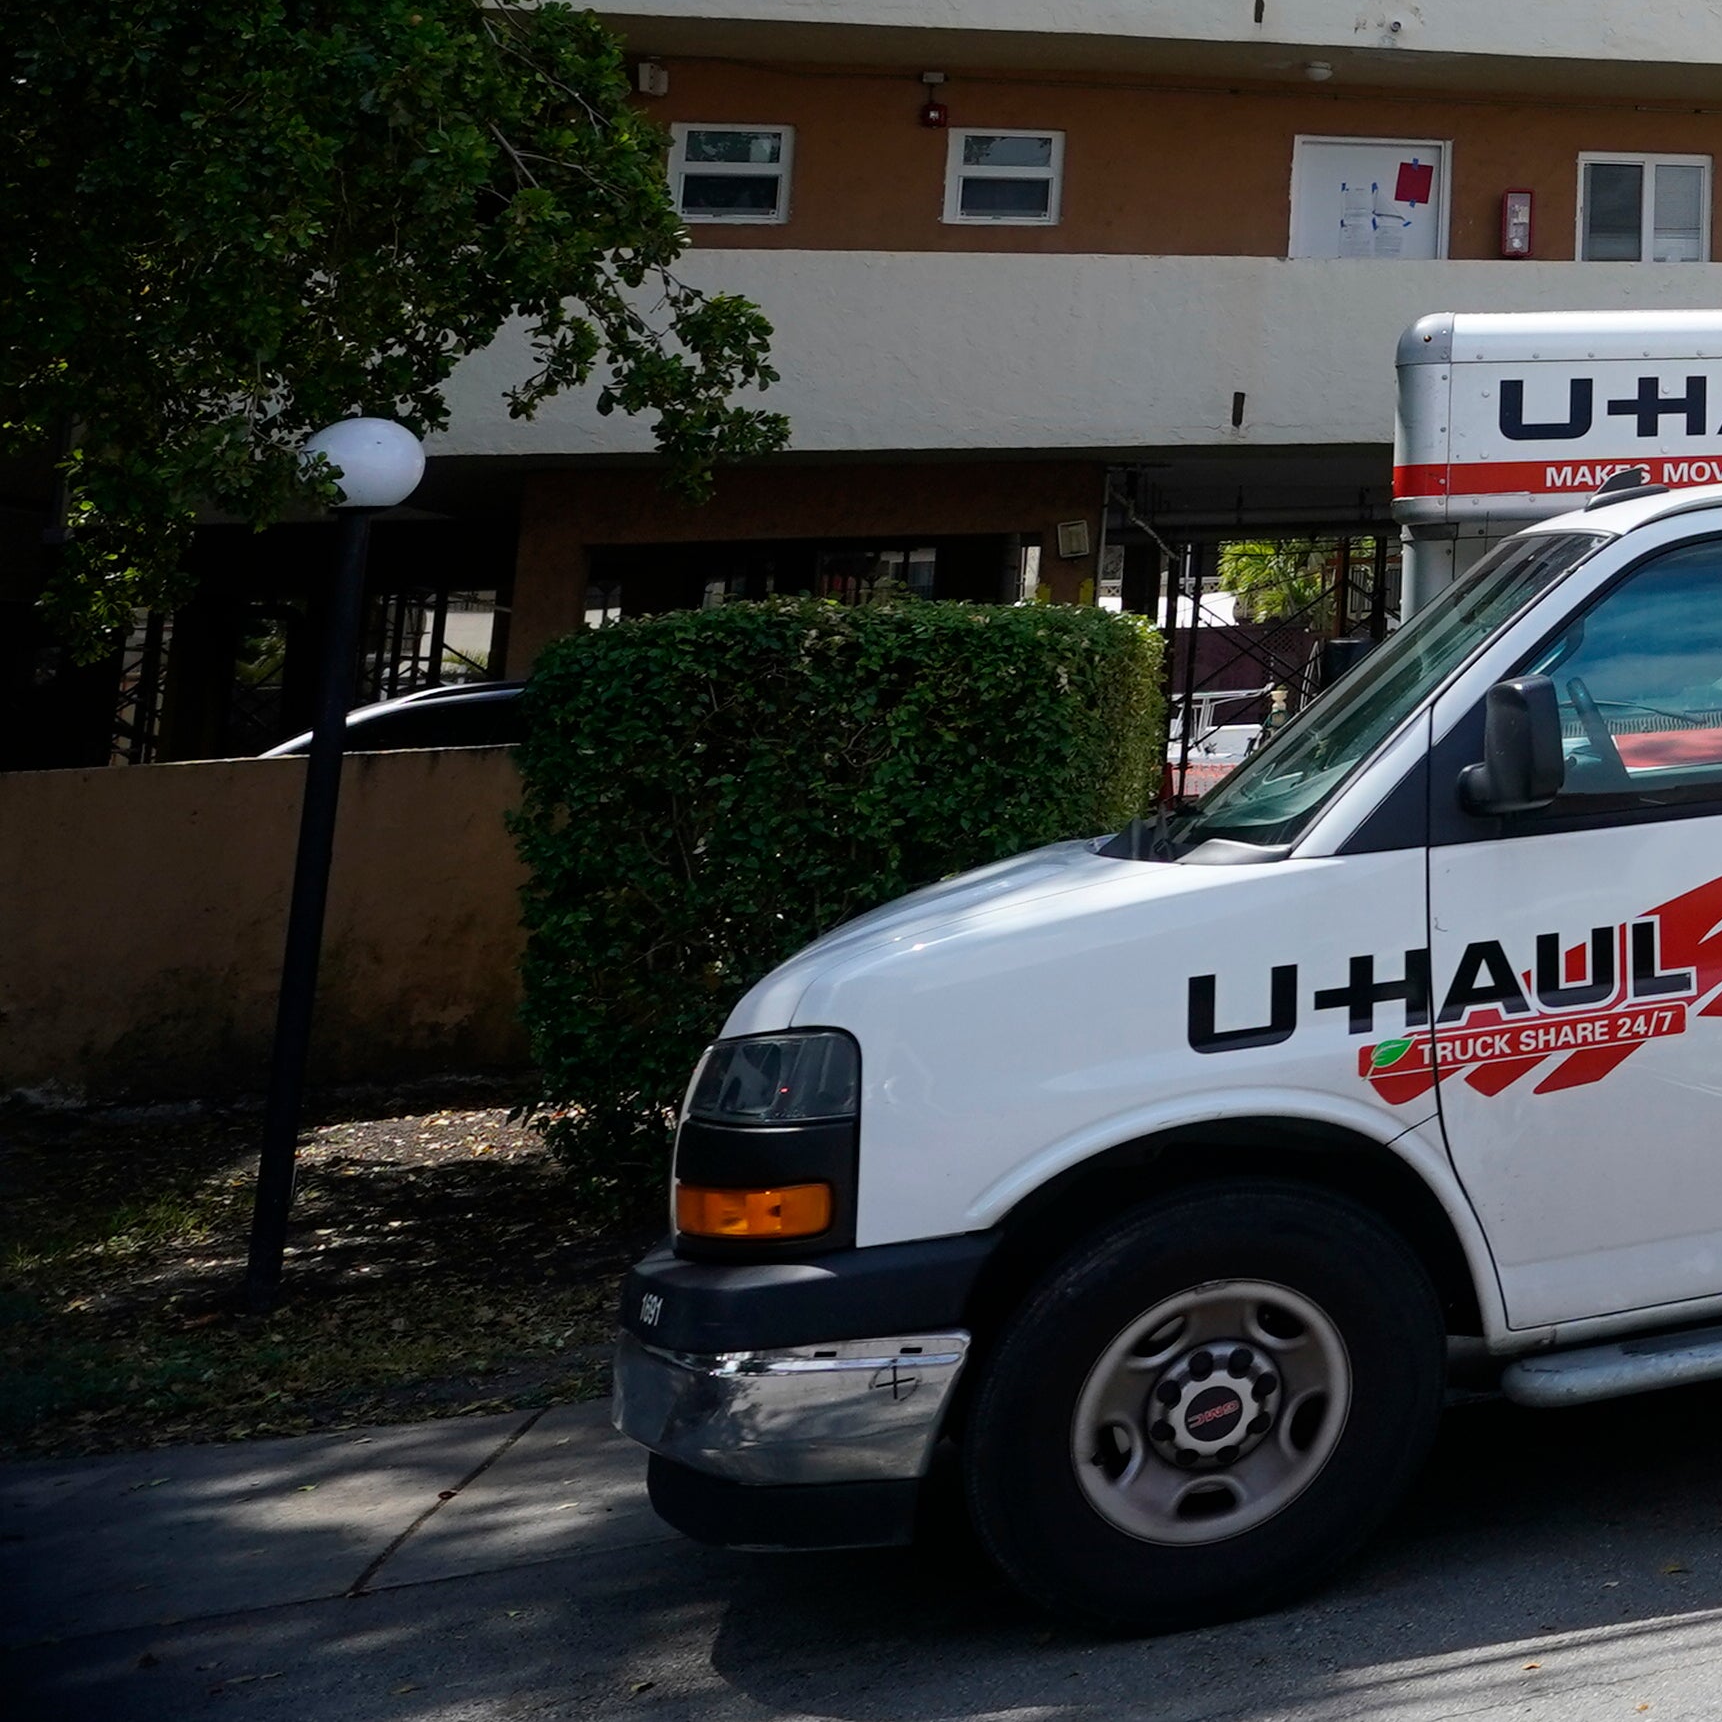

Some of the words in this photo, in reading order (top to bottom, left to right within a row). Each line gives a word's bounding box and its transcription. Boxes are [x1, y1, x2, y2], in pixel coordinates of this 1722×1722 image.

[1187, 920, 1692, 1054] U-HAUL
[1417, 1033, 1511, 1065] TRUCK
[1519, 1019, 1609, 1052] SHARE
[1616, 1010, 1675, 1038] 24/7
